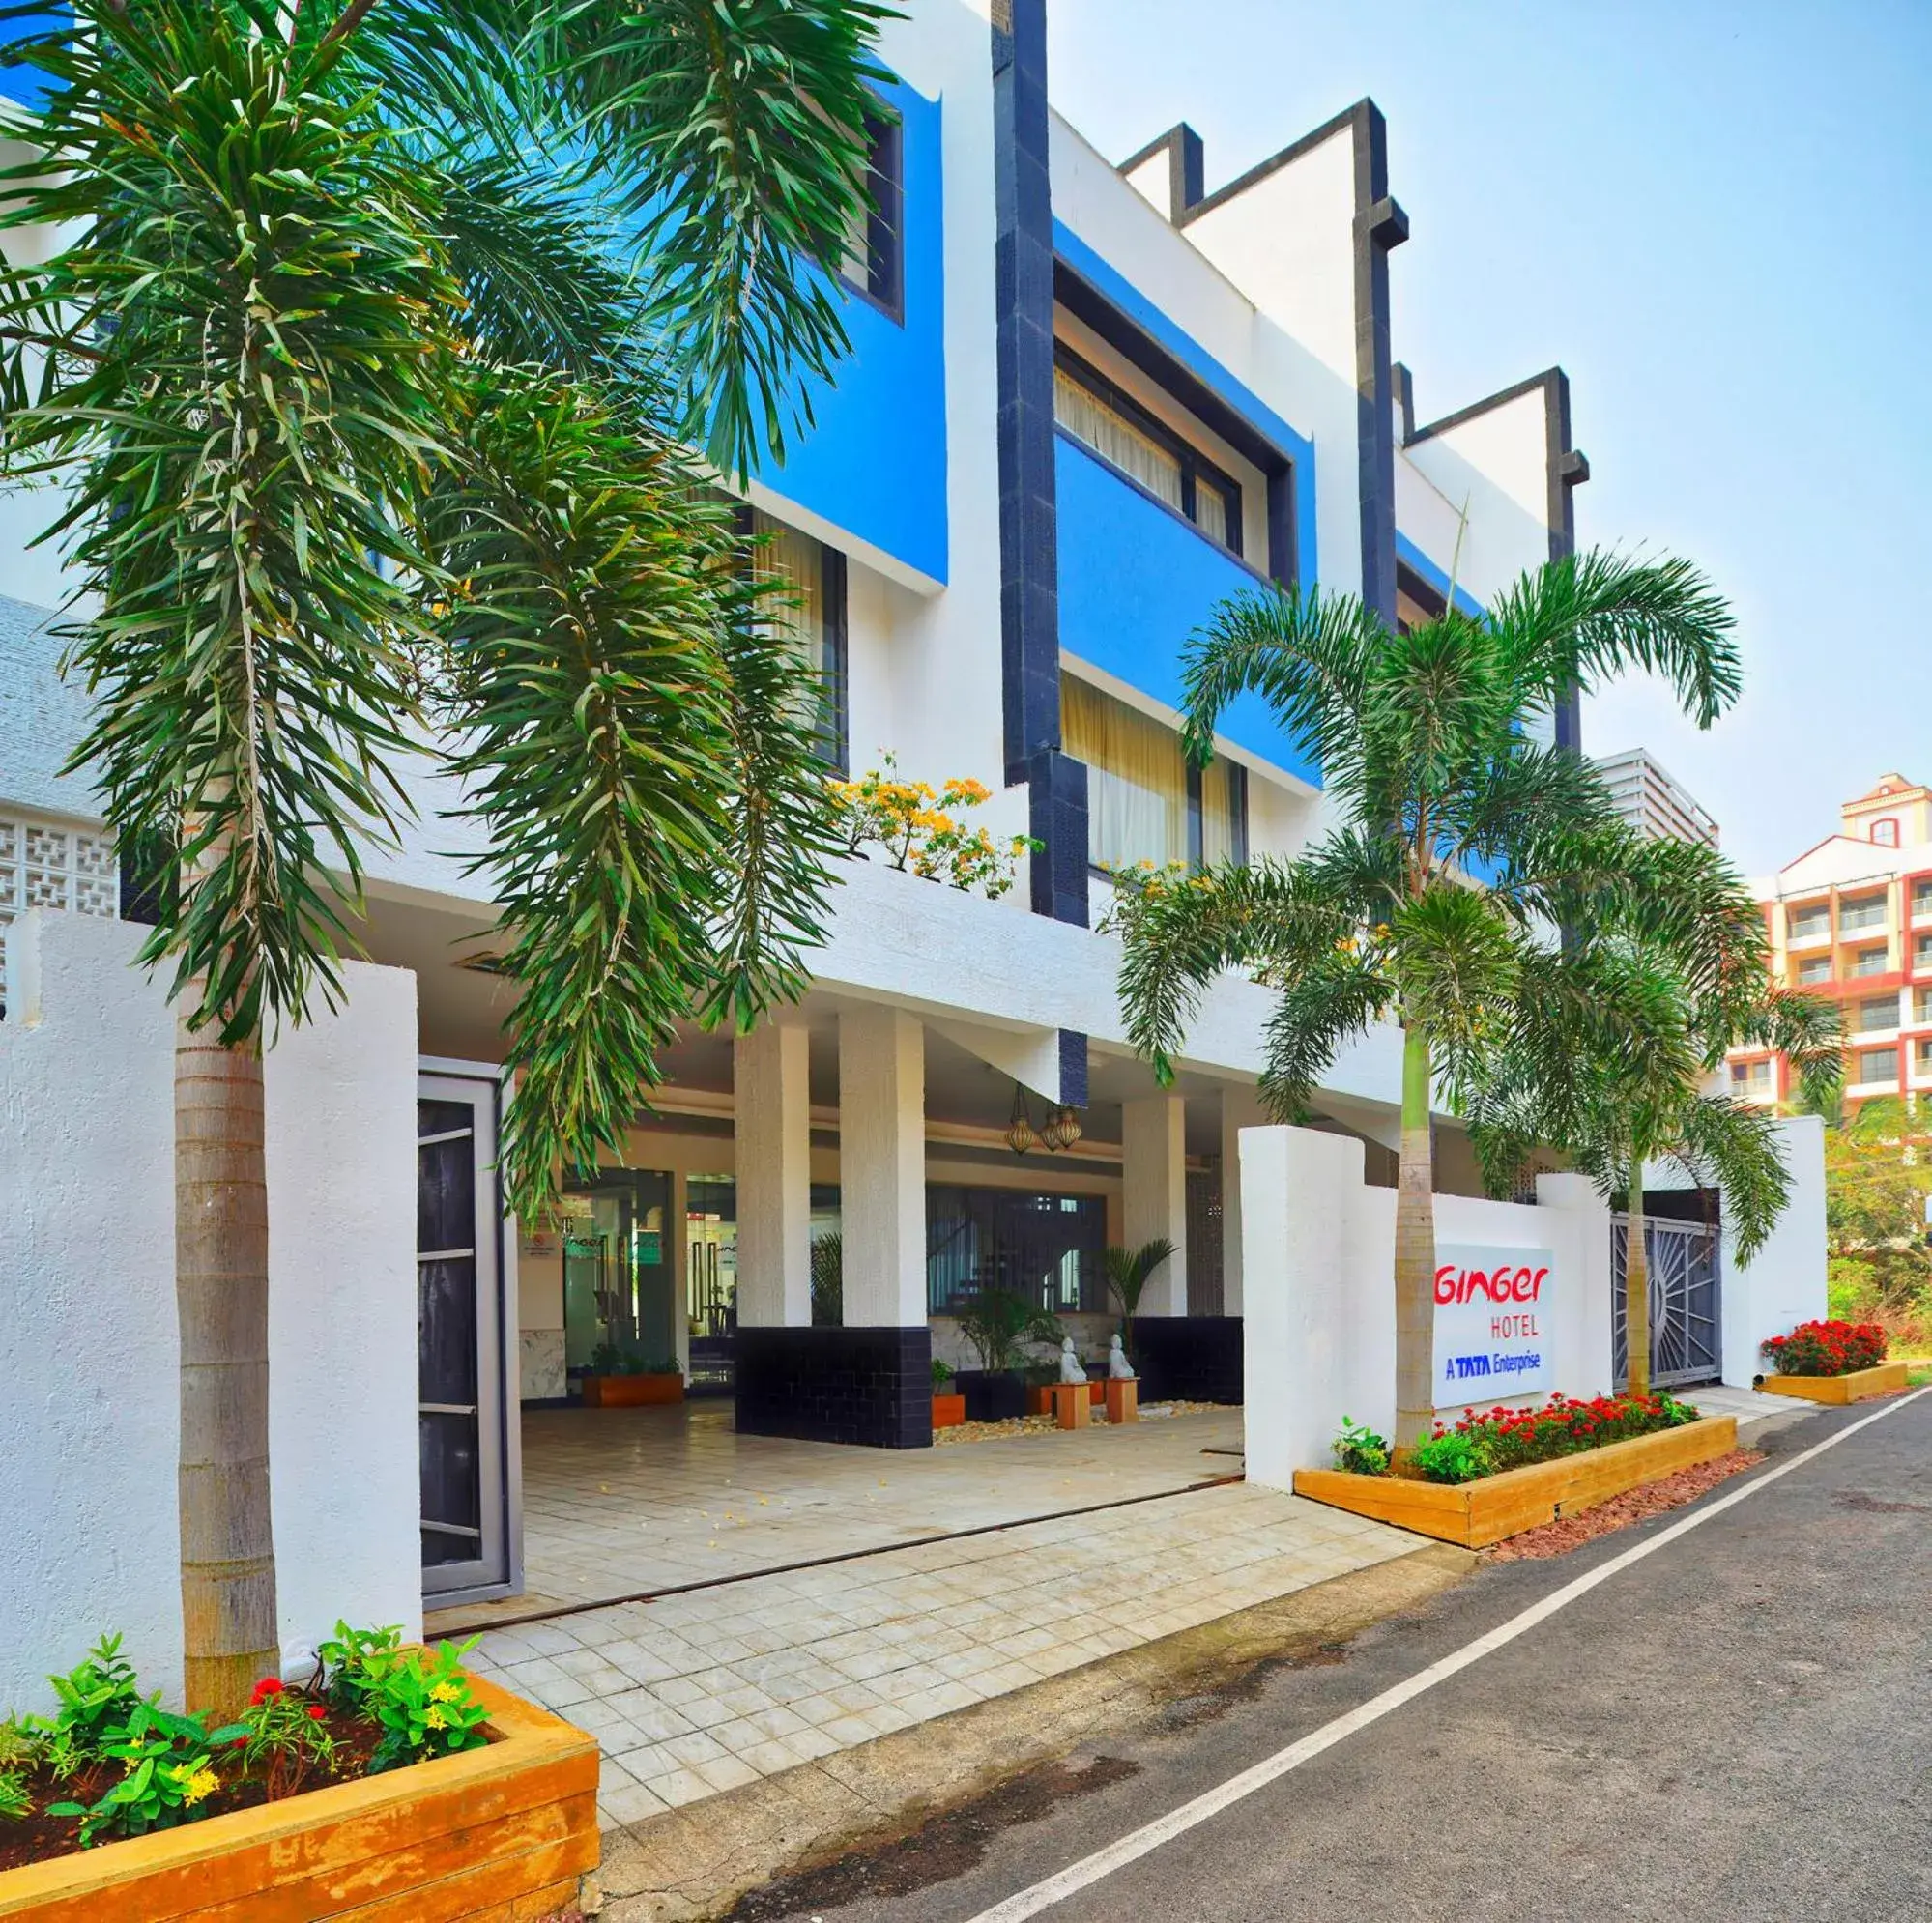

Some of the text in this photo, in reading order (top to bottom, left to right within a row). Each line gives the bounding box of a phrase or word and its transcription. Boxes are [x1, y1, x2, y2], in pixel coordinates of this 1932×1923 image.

[1491, 1314, 1539, 1339] HOTEL
[1446, 1349, 1541, 1380] A TATA Enterprise
